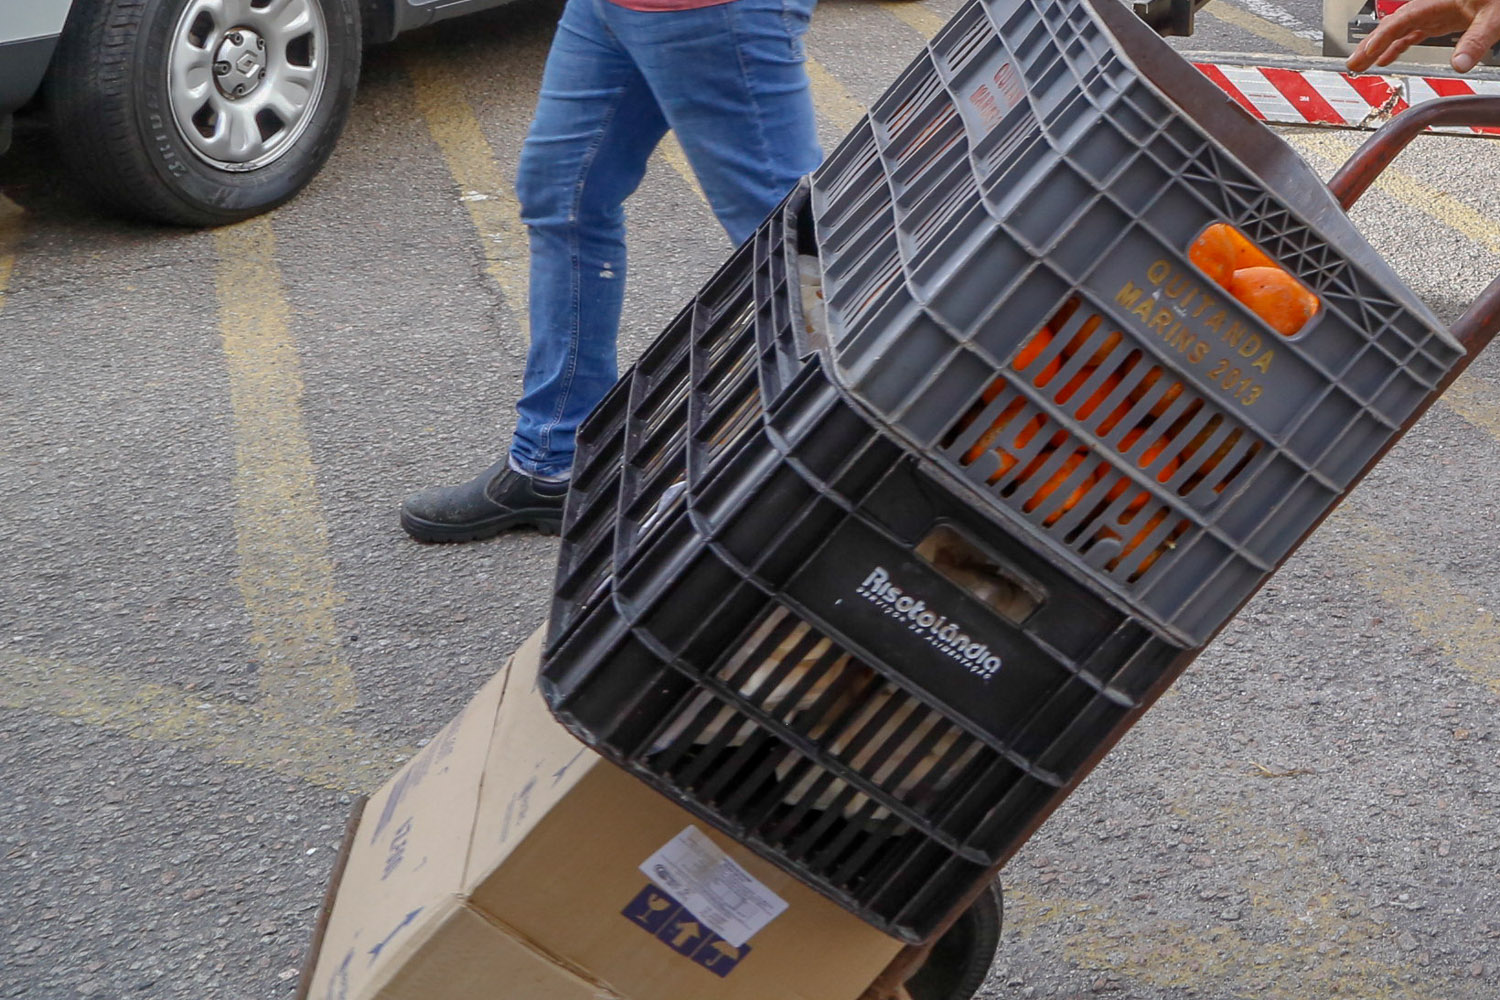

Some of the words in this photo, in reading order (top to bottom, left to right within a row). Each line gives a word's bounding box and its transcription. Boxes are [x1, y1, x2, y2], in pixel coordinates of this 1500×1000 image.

[1115, 280, 1211, 363] MARINS
[1206, 358, 1263, 406] 2013
[1147, 259, 1274, 374] QUITANDA
